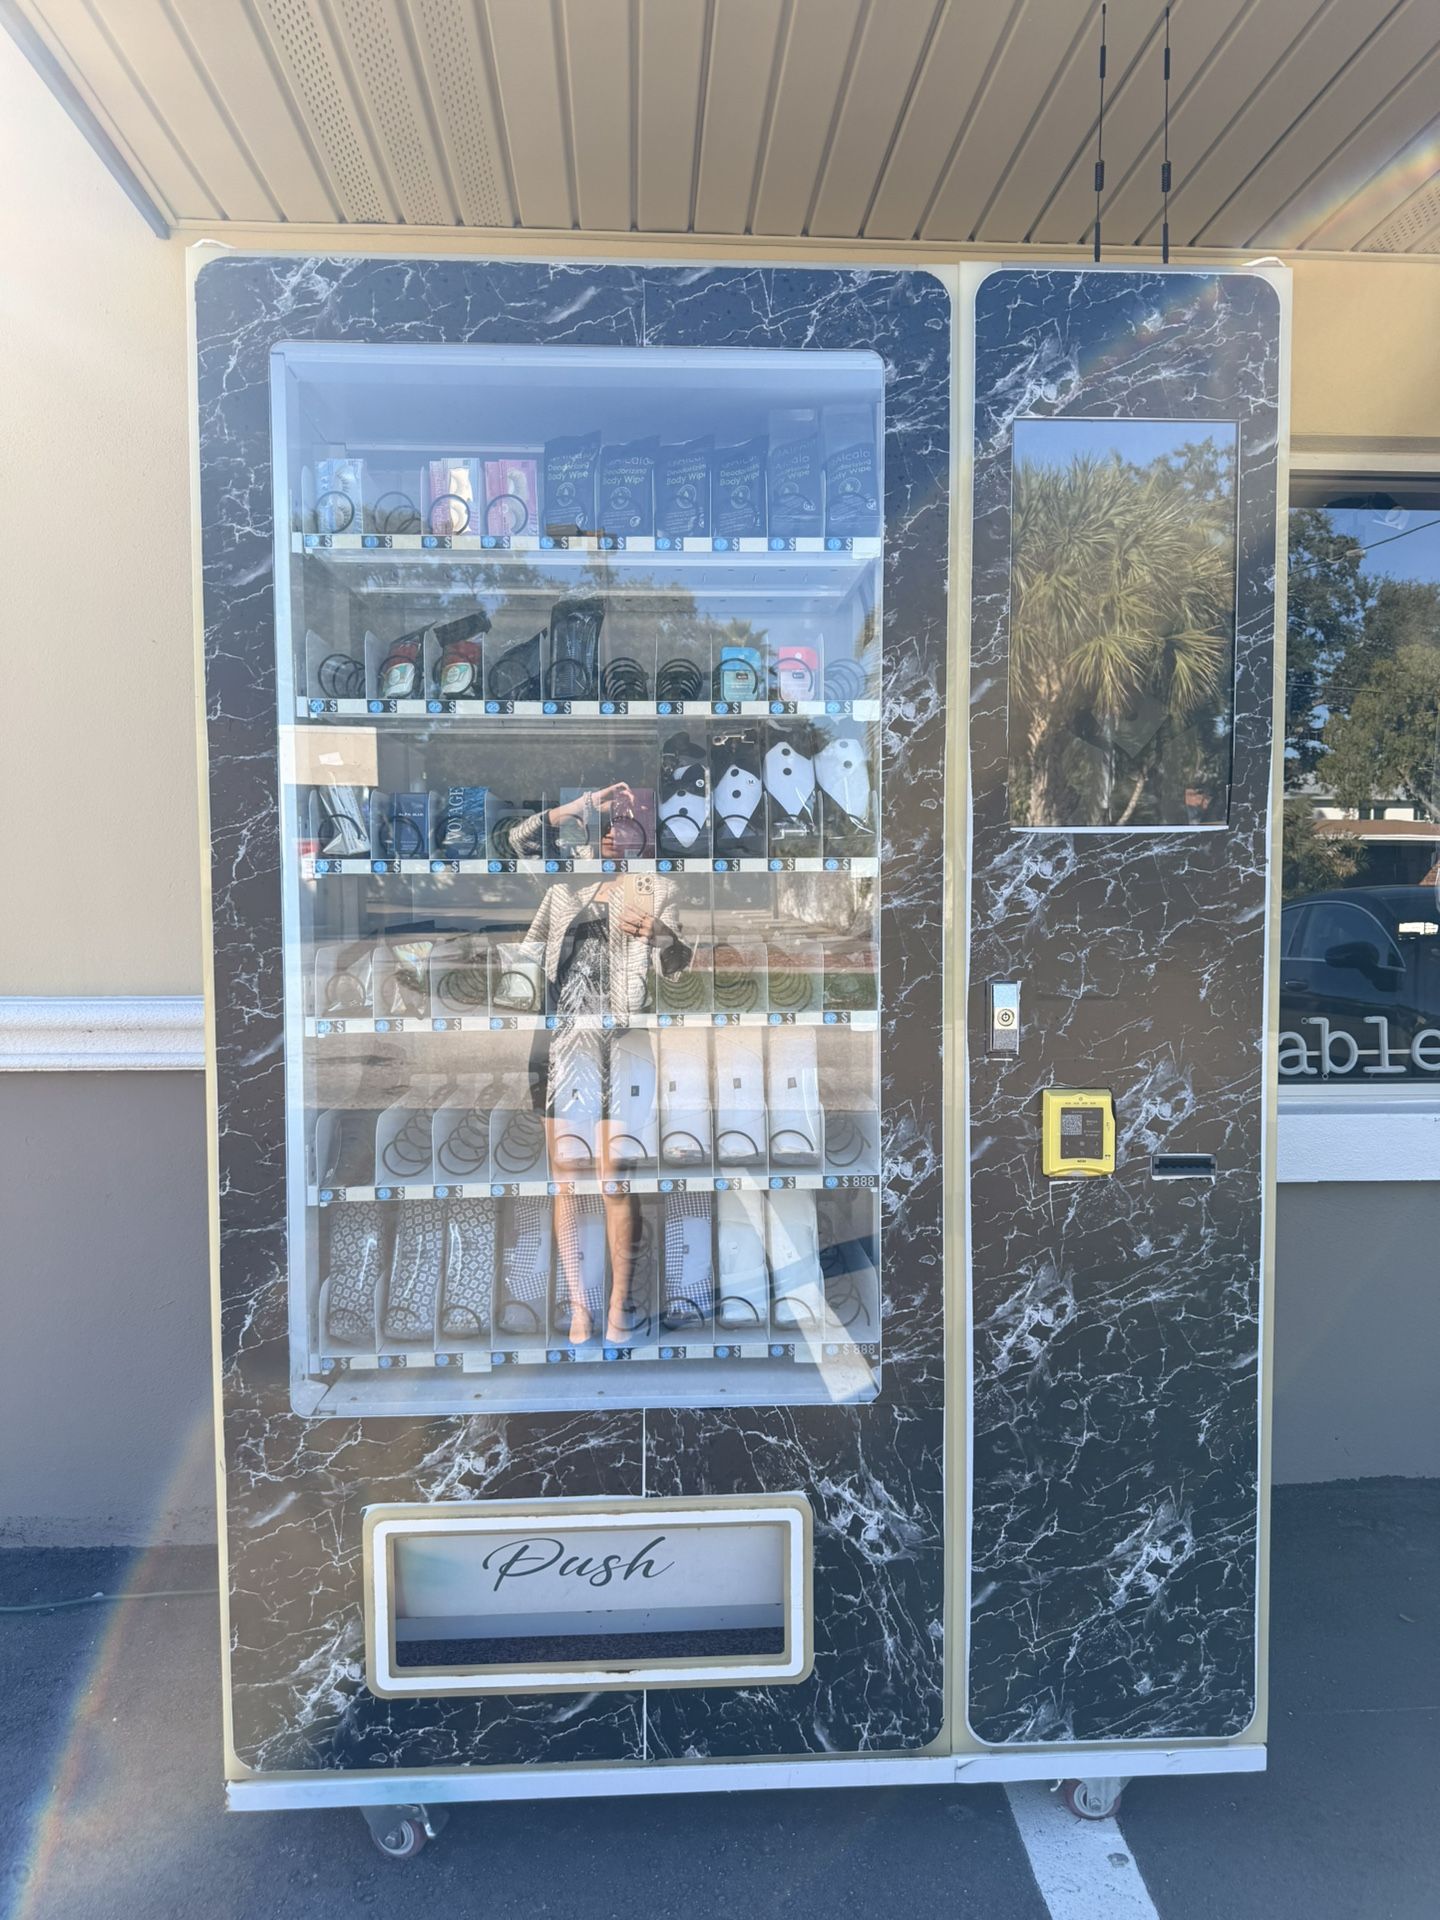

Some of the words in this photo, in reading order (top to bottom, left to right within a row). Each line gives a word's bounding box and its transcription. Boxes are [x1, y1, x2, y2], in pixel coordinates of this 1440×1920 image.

[447, 787, 464, 842] VOYAGE
[1278, 1016, 1440, 1075] able
[853, 1176, 875, 1187] 888
[853, 1344, 875, 1354] 888
[482, 1536, 675, 1592] Push
